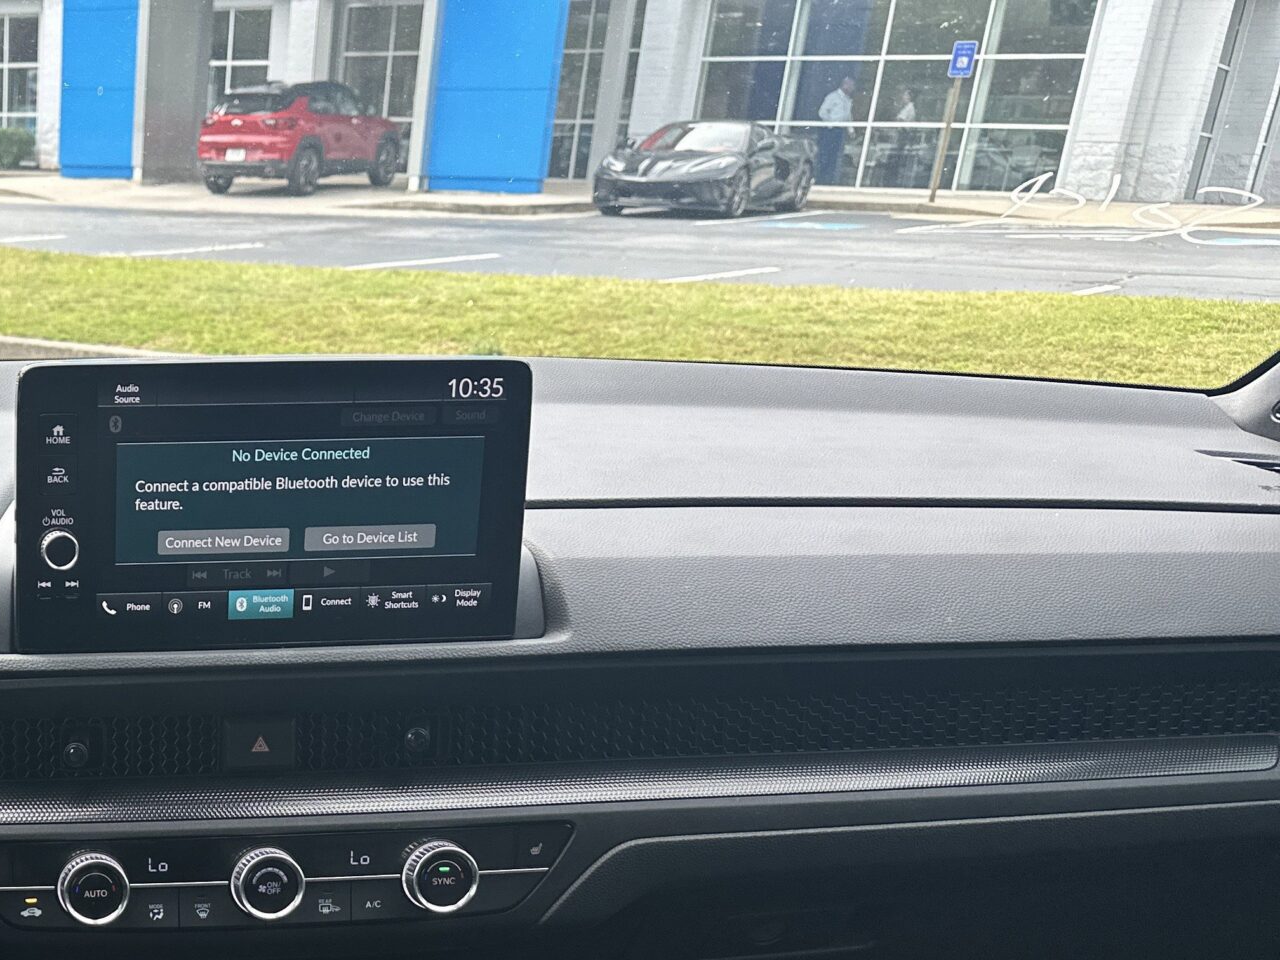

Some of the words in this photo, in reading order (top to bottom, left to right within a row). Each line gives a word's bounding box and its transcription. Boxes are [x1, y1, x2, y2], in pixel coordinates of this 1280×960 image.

[116, 384, 139, 393] Audio
[448, 378, 504, 398] 10:35
[114, 395, 141, 404] Source
[353, 411, 390, 423] Change
[392, 411, 425, 422] Device
[456, 410, 486, 420] Sound
[46, 436, 70, 444] HOME
[232, 450, 250, 462] No
[254, 448, 298, 461] Device
[302, 447, 370, 460] Connected
[47, 475, 69, 483] BACK
[135, 480, 188, 493] Connect
[192, 482, 199, 491] a
[202, 478, 272, 494] compatible
[276, 476, 338, 490] Bluetooth
[341, 475, 382, 488] device
[385, 476, 399, 487] to
[402, 476, 424, 486] use
[427, 474, 450, 486] this
[135, 498, 183, 511] feature.
[51, 517, 73, 525] AUDIO
[165, 536, 212, 549] Connect
[215, 536, 240, 547] New
[243, 535, 282, 547] Device
[323, 533, 339, 545] Go
[342, 534, 354, 544] to
[357, 532, 395, 543] Device
[398, 531, 417, 543] List
[223, 568, 252, 579] Track
[391, 591, 413, 599] Smart
[455, 589, 481, 599] Display
[252, 595, 288, 603] Bluetooth
[321, 597, 352, 606] Connect
[456, 598, 477, 607] Mode
[126, 602, 150, 611] Phone
[198, 601, 211, 609] FM
[259, 604, 281, 613] Audio
[384, 600, 419, 609] Shortcuts
[350, 850, 370, 865] Lo
[148, 857, 168, 873] Lo
[432, 877, 455, 886] SYNC
[84, 889, 108, 898] AUTO
[365, 900, 381, 908] A/C
